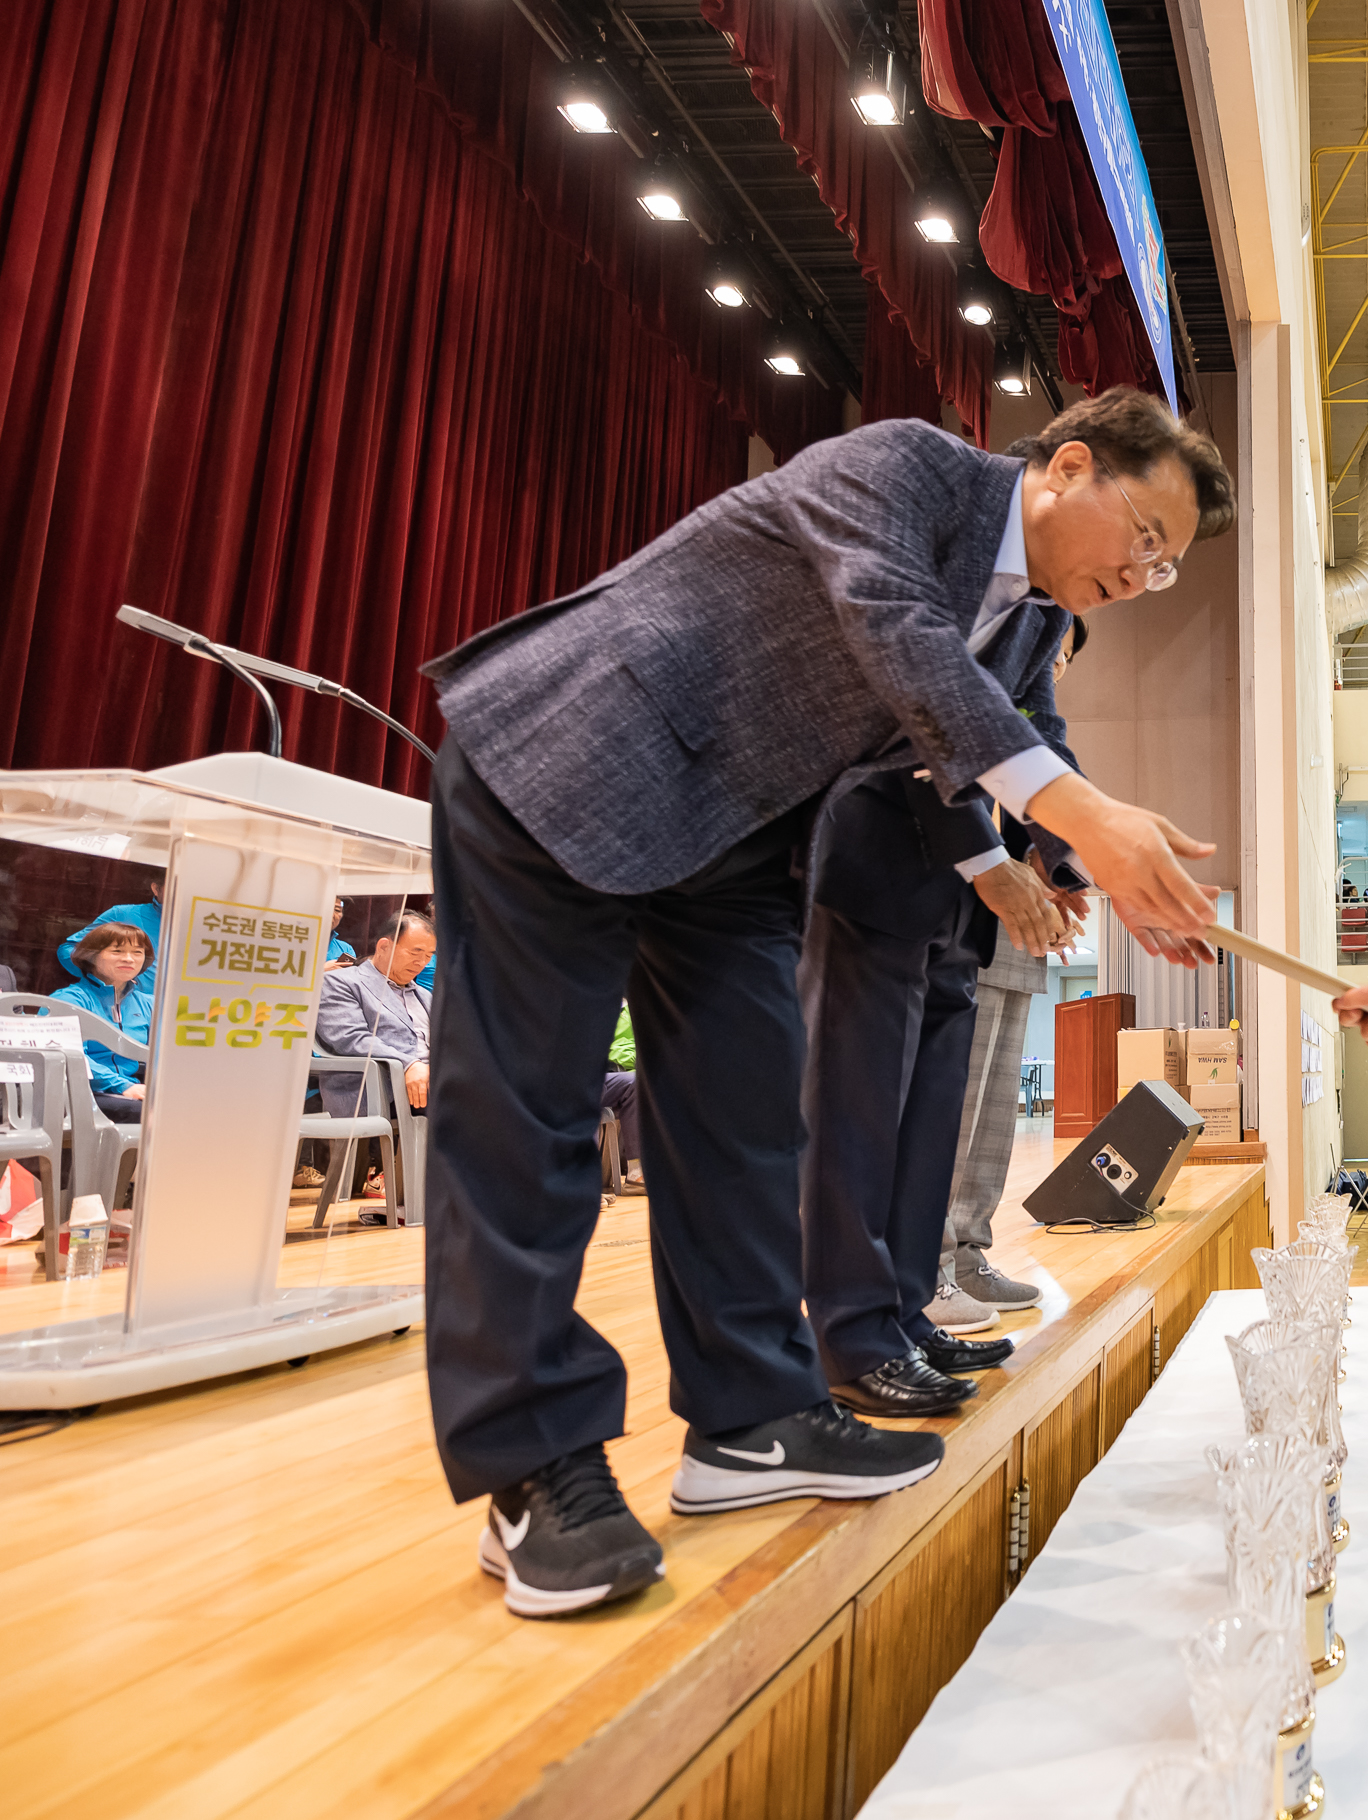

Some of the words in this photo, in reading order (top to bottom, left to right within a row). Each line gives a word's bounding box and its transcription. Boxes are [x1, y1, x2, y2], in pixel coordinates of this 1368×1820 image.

[202, 912, 257, 937] 수도권
[260, 919, 310, 944] 동북부
[198, 938, 307, 978] 거점도시
[175, 995, 309, 1050] 남양주
